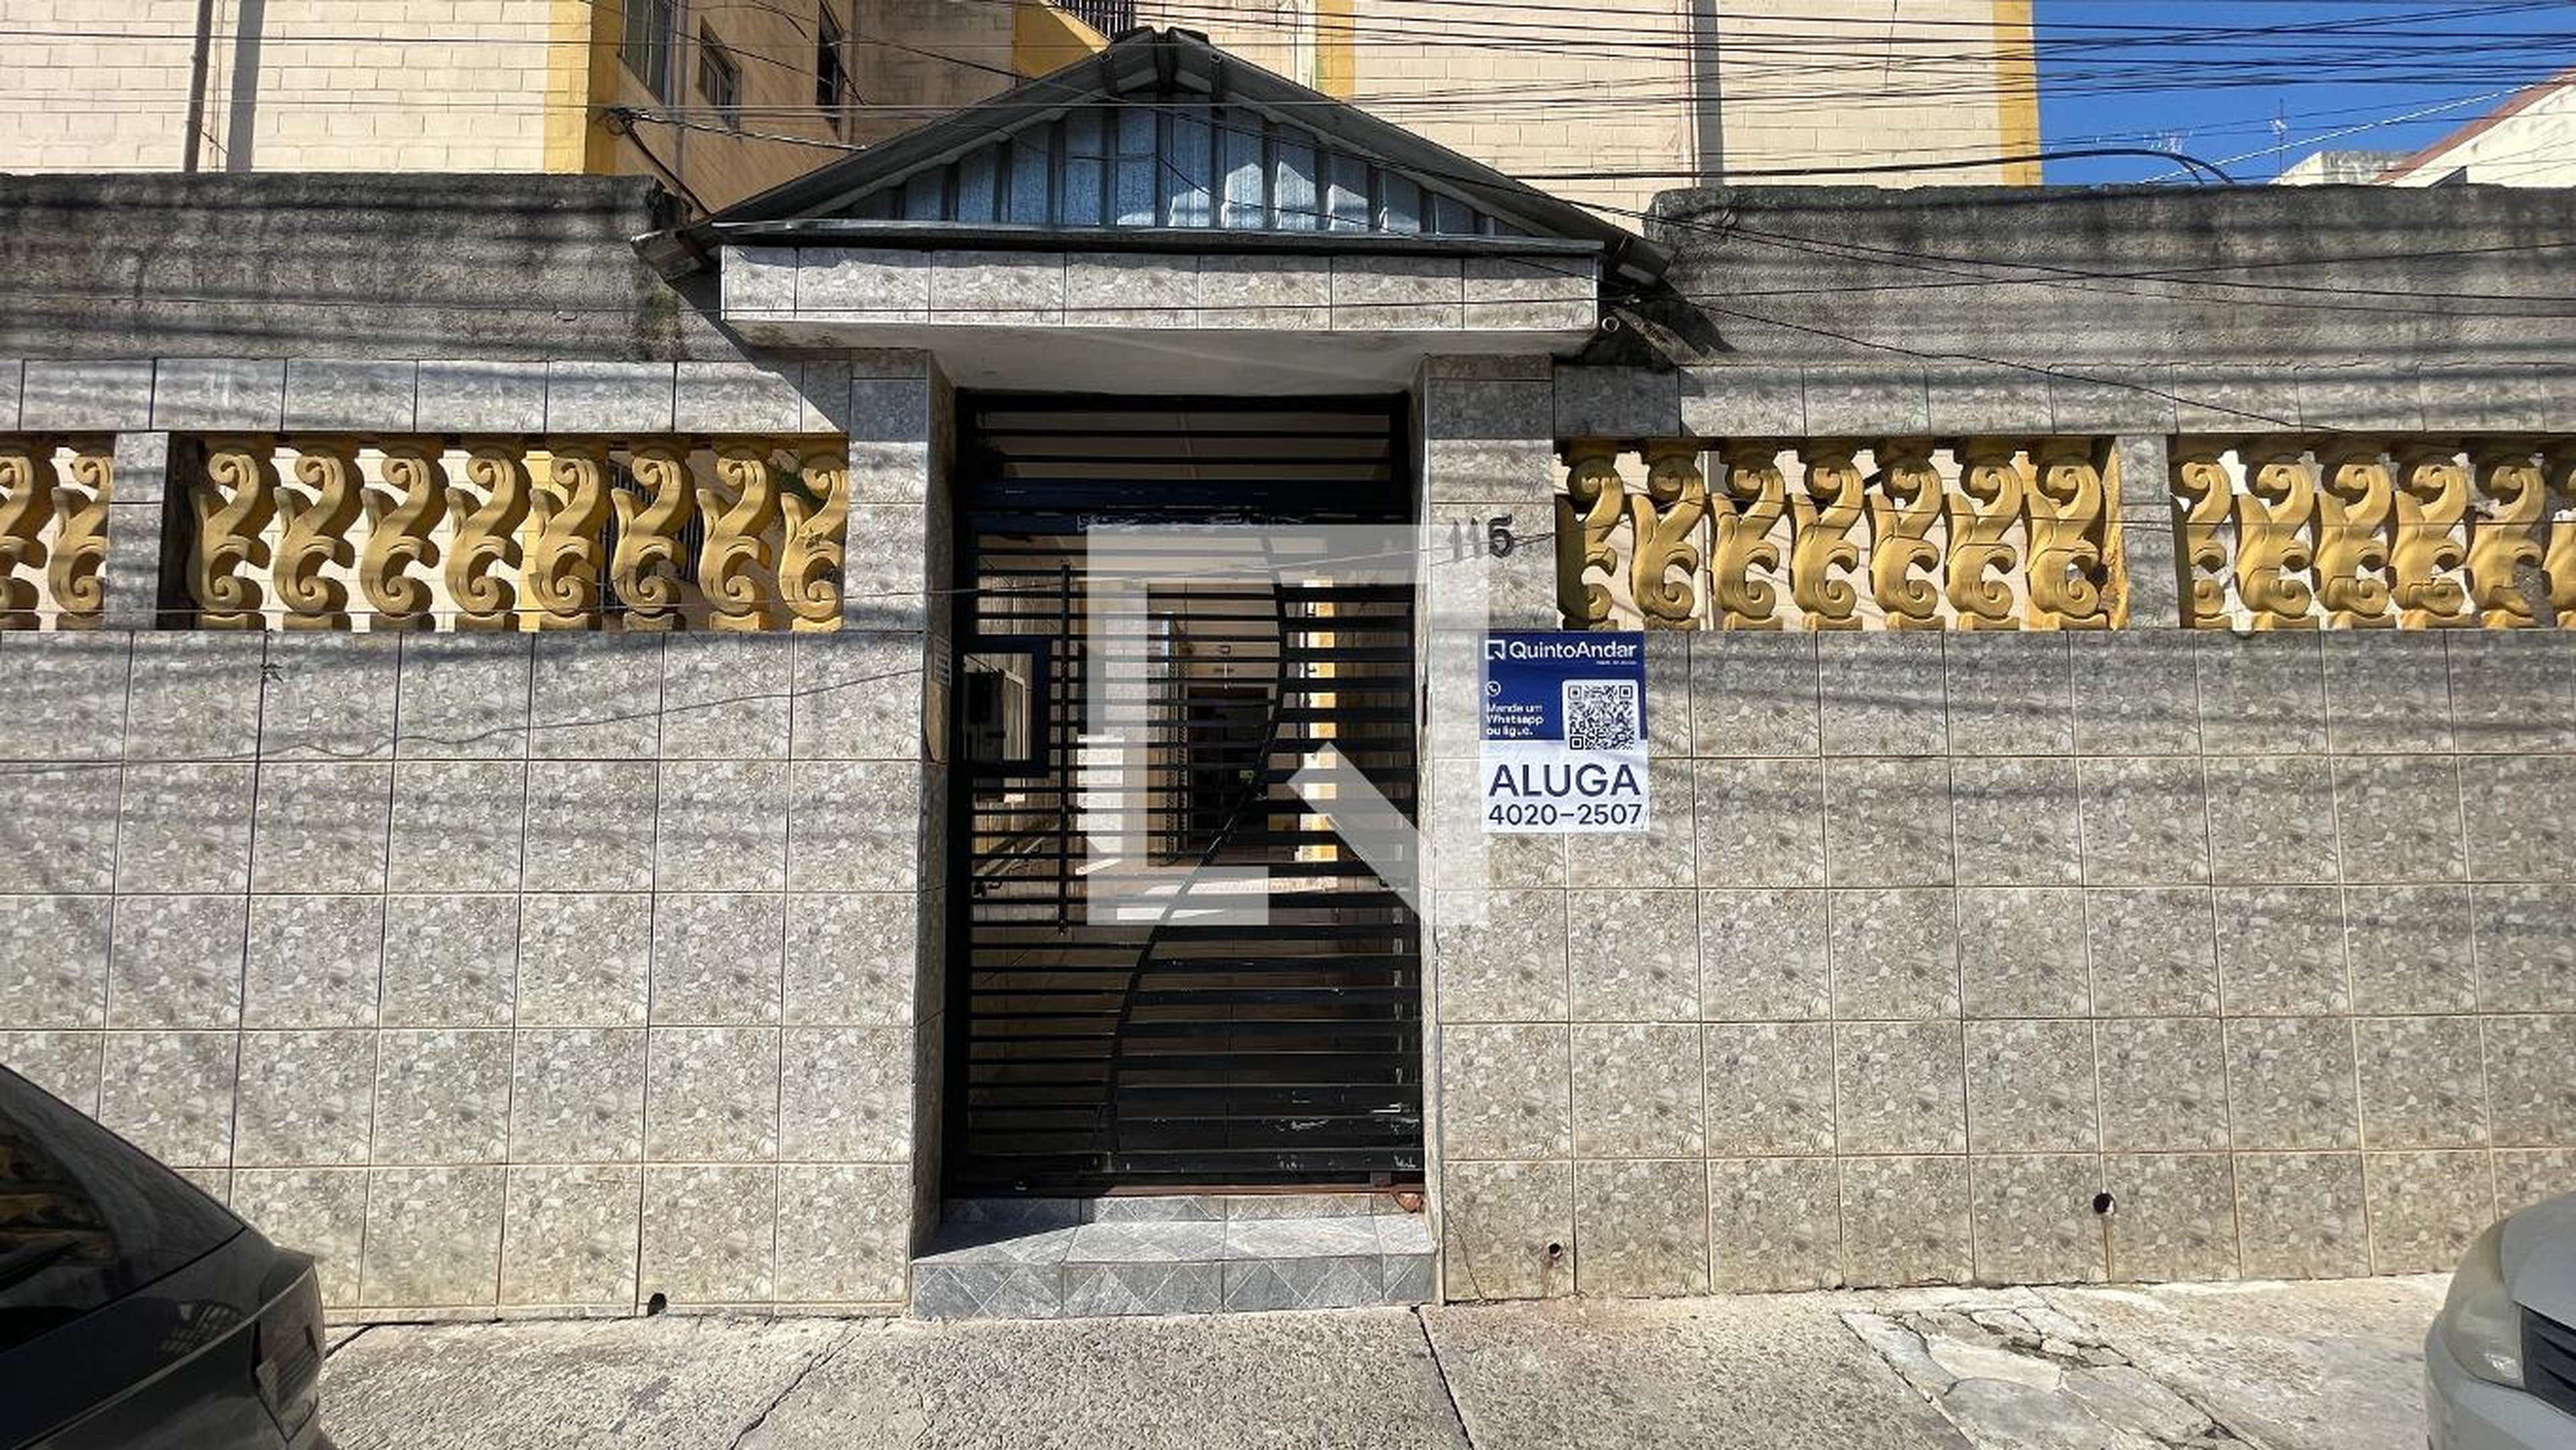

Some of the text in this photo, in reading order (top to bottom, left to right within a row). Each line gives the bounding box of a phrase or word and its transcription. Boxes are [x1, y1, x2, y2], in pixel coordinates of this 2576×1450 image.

[1509, 641, 1637, 660] QuintoAndar
[1486, 727, 1501, 735] ou
[1489, 763, 1642, 797] ALUGA
[1489, 805, 1643, 826] 4020-2507
